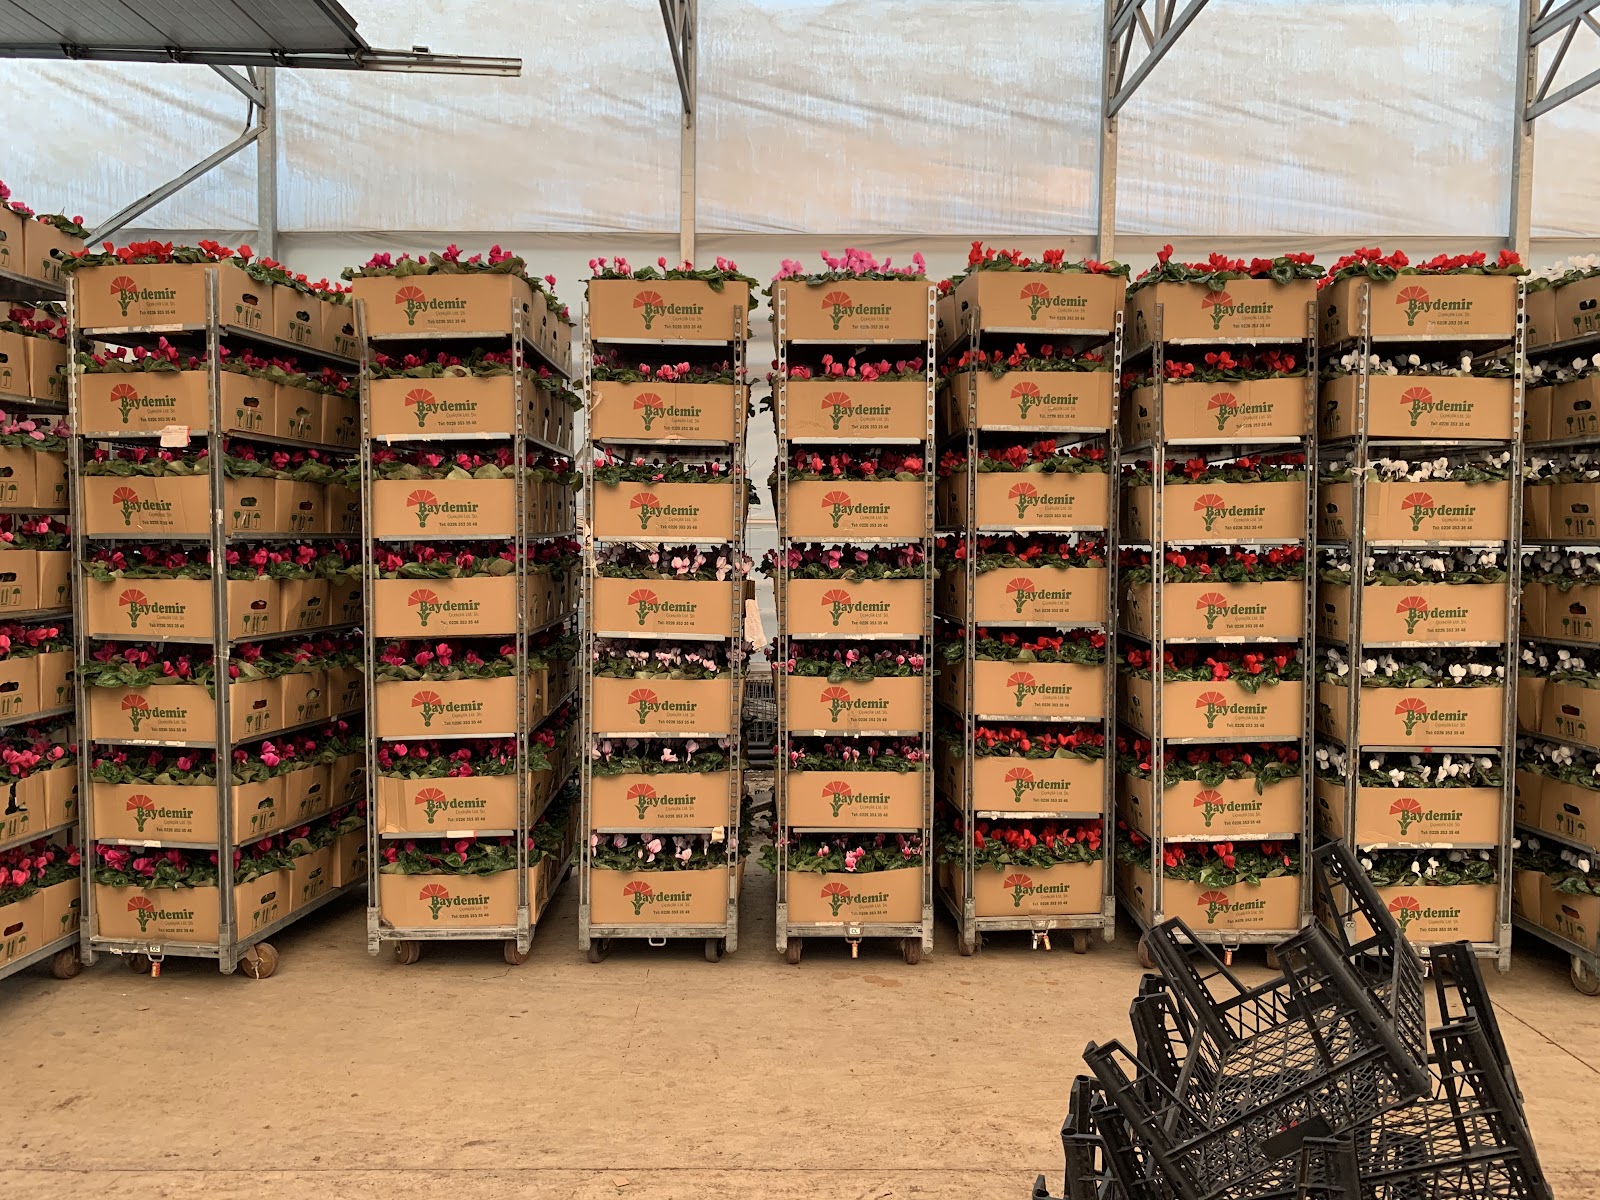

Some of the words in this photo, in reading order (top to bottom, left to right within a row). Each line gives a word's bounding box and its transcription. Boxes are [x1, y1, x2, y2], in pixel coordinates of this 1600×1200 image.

[120, 288, 176, 302] Baydemir
[1032, 295, 1087, 308] Baydemir
[407, 298, 466, 311] Baydemir
[645, 303, 703, 317] Baydemir
[833, 303, 891, 317] Baydemir
[1214, 302, 1273, 316] Baydemir
[1408, 298, 1472, 312] Baydemir
[121, 396, 176, 409] Baydemir
[1022, 393, 1078, 406] Baydemir
[1412, 399, 1474, 413] Baydemir
[417, 400, 477, 413] Baydemir
[644, 405, 701, 418] Baydemir
[833, 404, 891, 417] Baydemir
[1219, 403, 1273, 417] Baydemir
[1019, 493, 1075, 506] Baydemir
[419, 502, 478, 514] Baydemir
[641, 503, 699, 517] Baydemir
[833, 503, 890, 516] Baydemir
[1206, 505, 1265, 518] Baydemir
[1414, 504, 1476, 518] Baydemir
[1017, 589, 1071, 602] Baydemir
[130, 601, 185, 614] Baydemir
[420, 600, 480, 613] Baydemir
[639, 600, 696, 614] Baydemir
[833, 601, 890, 614] Baydemir
[1208, 604, 1266, 617] Baydemir
[1408, 607, 1468, 620] Baydemir
[1018, 683, 1072, 695] Baydemir
[423, 701, 483, 714] Baydemir
[640, 700, 697, 713] Baydemir
[832, 698, 889, 711] Baydemir
[1207, 703, 1267, 716] Baydemir
[132, 706, 187, 719] Baydemir
[1406, 710, 1468, 722] Baydemir
[1016, 778, 1071, 791] Baydemir
[426, 798, 486, 811] Baydemir
[638, 794, 696, 807] Baydemir
[833, 792, 890, 805] Baydemir
[137, 806, 193, 820] Baydemir
[1205, 800, 1262, 813] Baydemir
[1401, 810, 1462, 823] Baydemir
[1014, 883, 1070, 895] Baydemir
[431, 895, 489, 907] Baydemir
[634, 891, 692, 904] Baydemir
[832, 892, 889, 904] Baydemir
[1209, 899, 1266, 913] Baydemir
[139, 908, 194, 920] Baydemir
[1400, 907, 1460, 920] Baydemir
